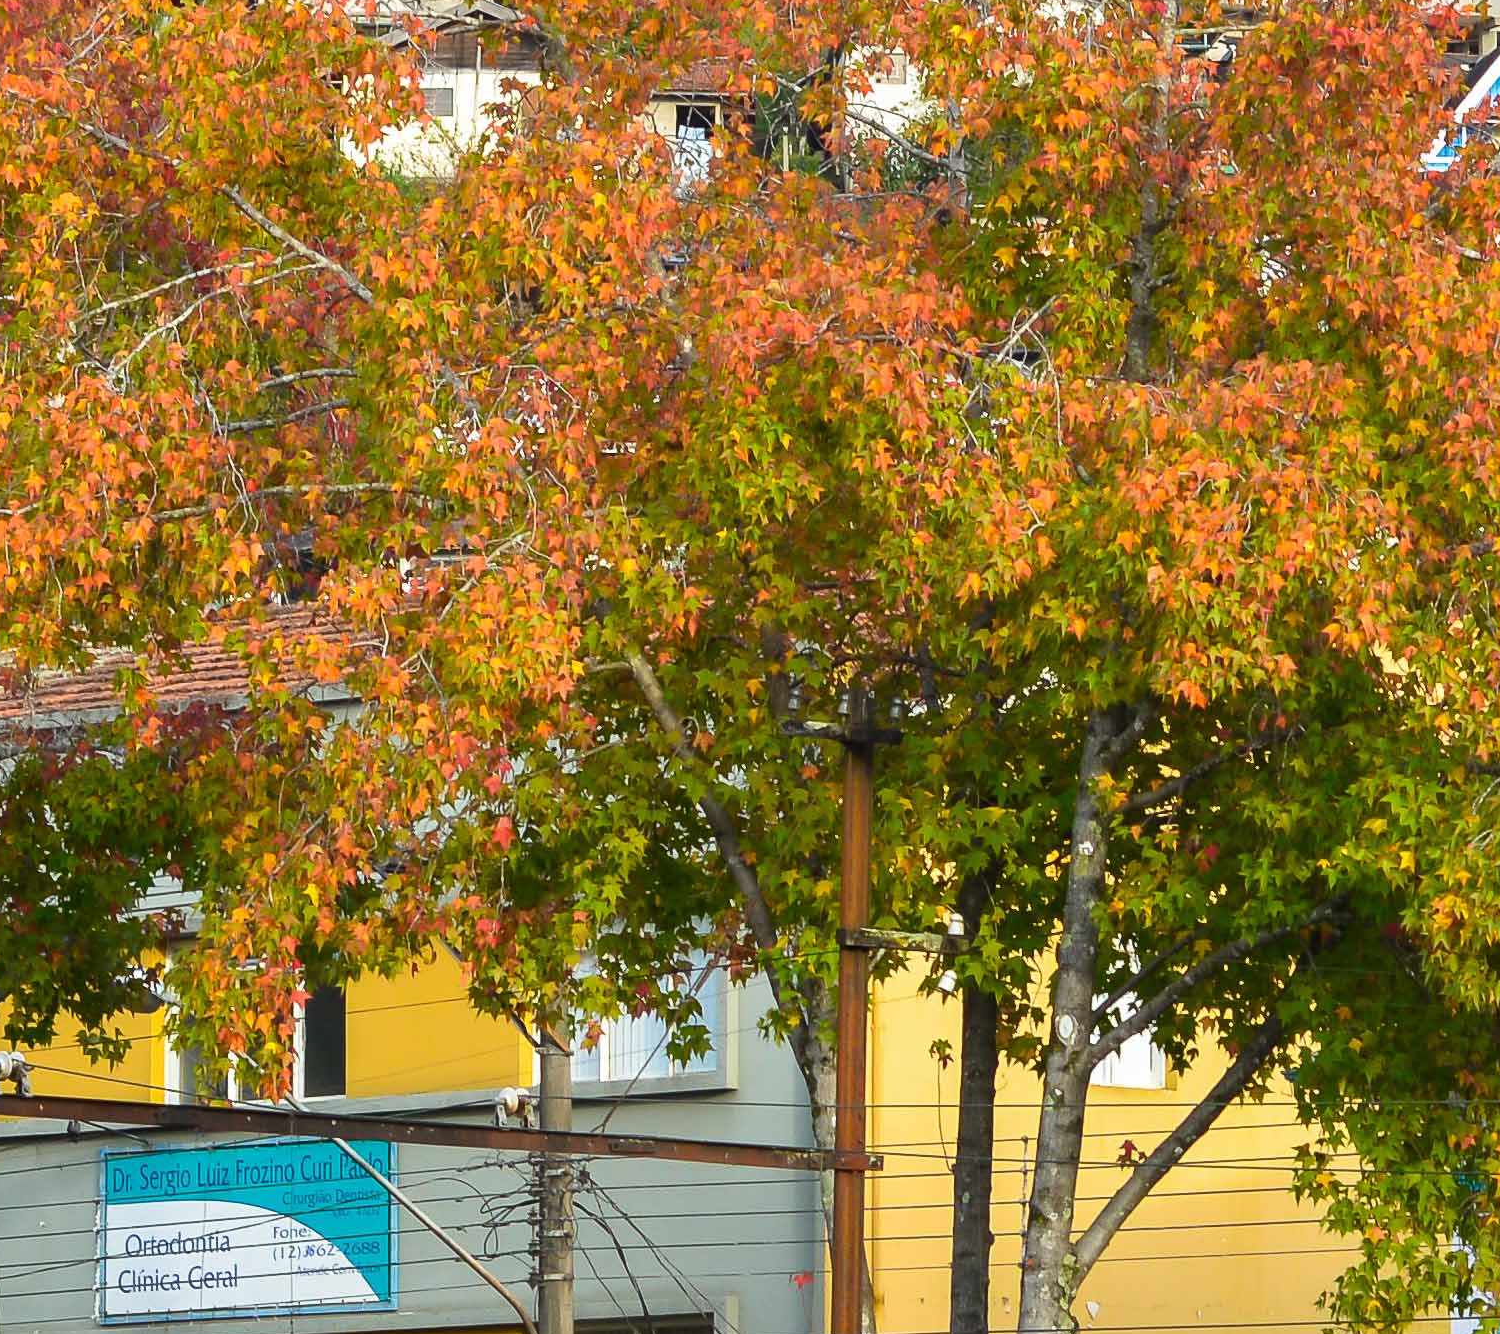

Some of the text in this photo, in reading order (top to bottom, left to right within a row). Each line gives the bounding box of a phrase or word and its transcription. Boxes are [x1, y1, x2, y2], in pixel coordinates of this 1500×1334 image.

[112, 1167, 134, 1193] Dr.
[139, 1164, 191, 1196] Sergio
[197, 1163, 229, 1188] Luiz
[235, 1158, 295, 1185] Frozino
[300, 1153, 333, 1181] Curi
[125, 1231, 231, 1258] Ortodontia
[272, 1226, 312, 1240] Fone:
[118, 1263, 238, 1294] Clínica Geral
